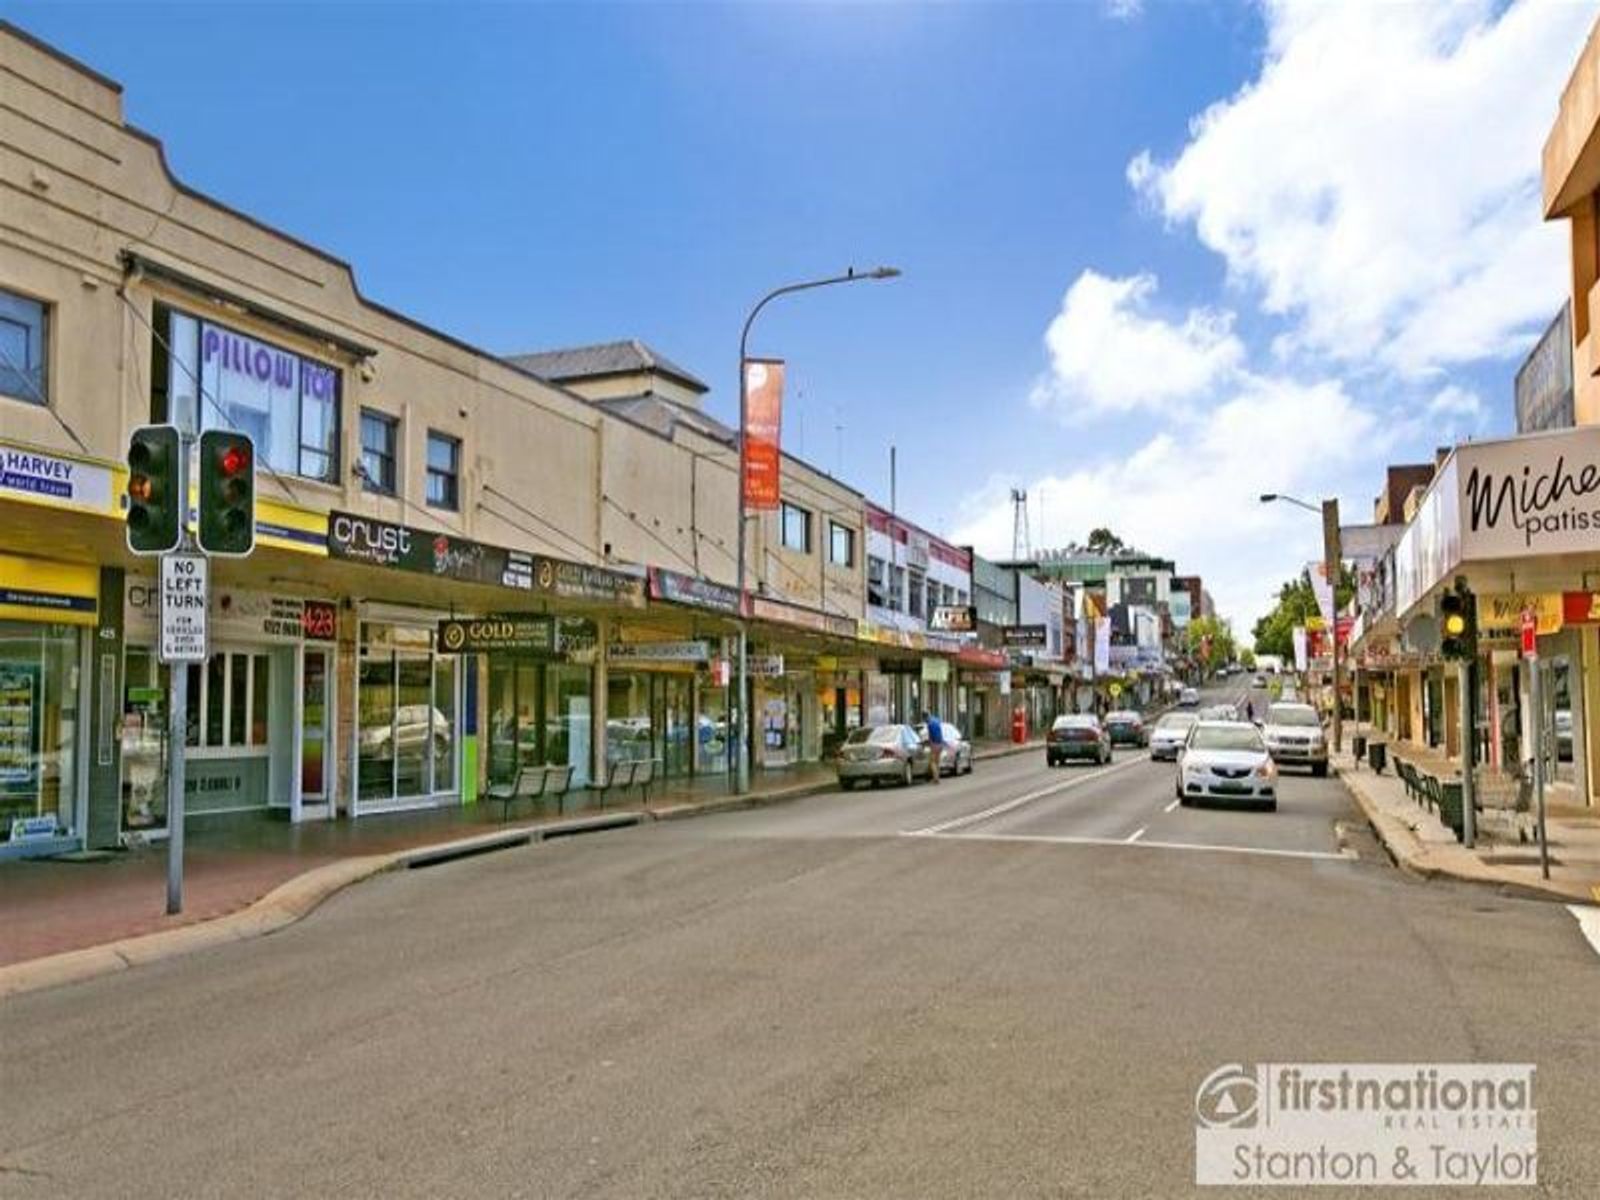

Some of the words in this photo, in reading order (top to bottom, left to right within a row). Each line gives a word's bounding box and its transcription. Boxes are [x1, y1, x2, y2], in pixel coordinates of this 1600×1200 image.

[204, 329, 293, 389] PILLOW
[7, 452, 73, 480] HARVEY
[334, 517, 411, 554] crust
[174, 561, 195, 575] NO
[166, 578, 202, 592] LEFT
[166, 594, 203, 608] TURN
[470, 622, 513, 638] GOLD
